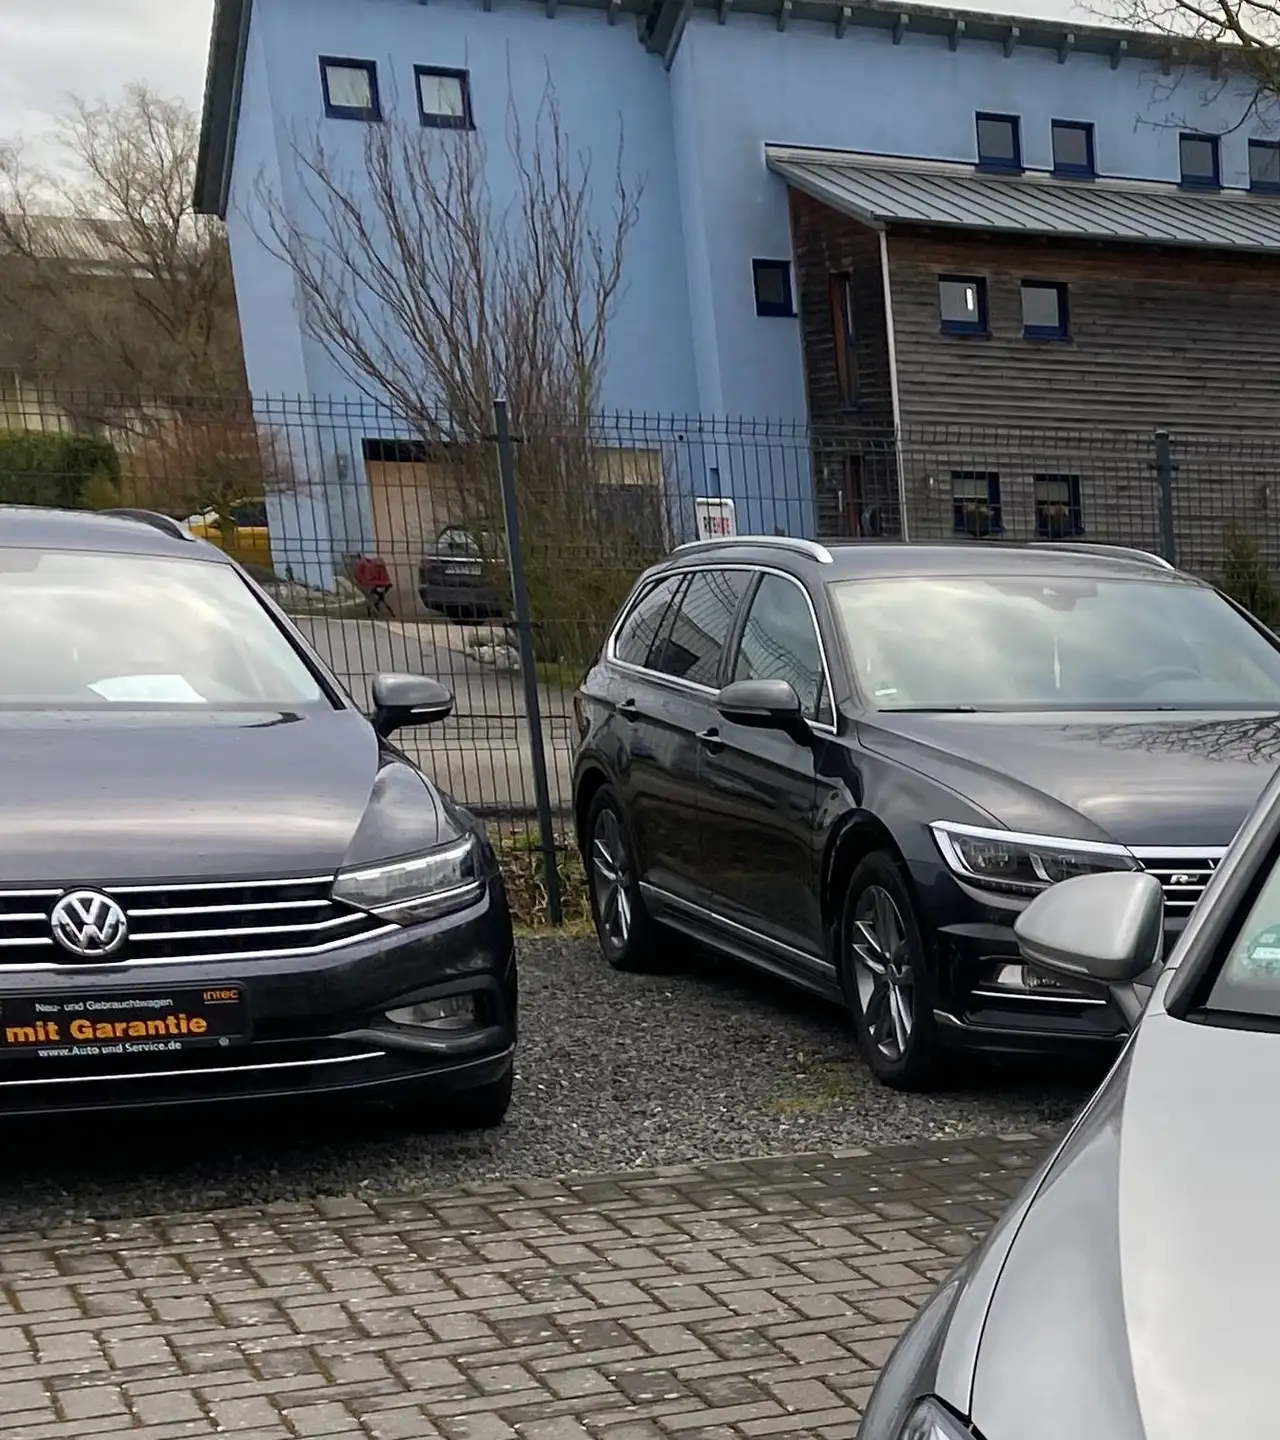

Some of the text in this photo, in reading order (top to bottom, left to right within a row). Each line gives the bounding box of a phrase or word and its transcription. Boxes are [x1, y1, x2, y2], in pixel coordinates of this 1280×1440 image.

[35, 998, 173, 1012] Neu- und Gebrauchtwagen
[6, 1013, 208, 1043] mit Garantie
[38, 1041, 182, 1057] www.Auto und Service.de
